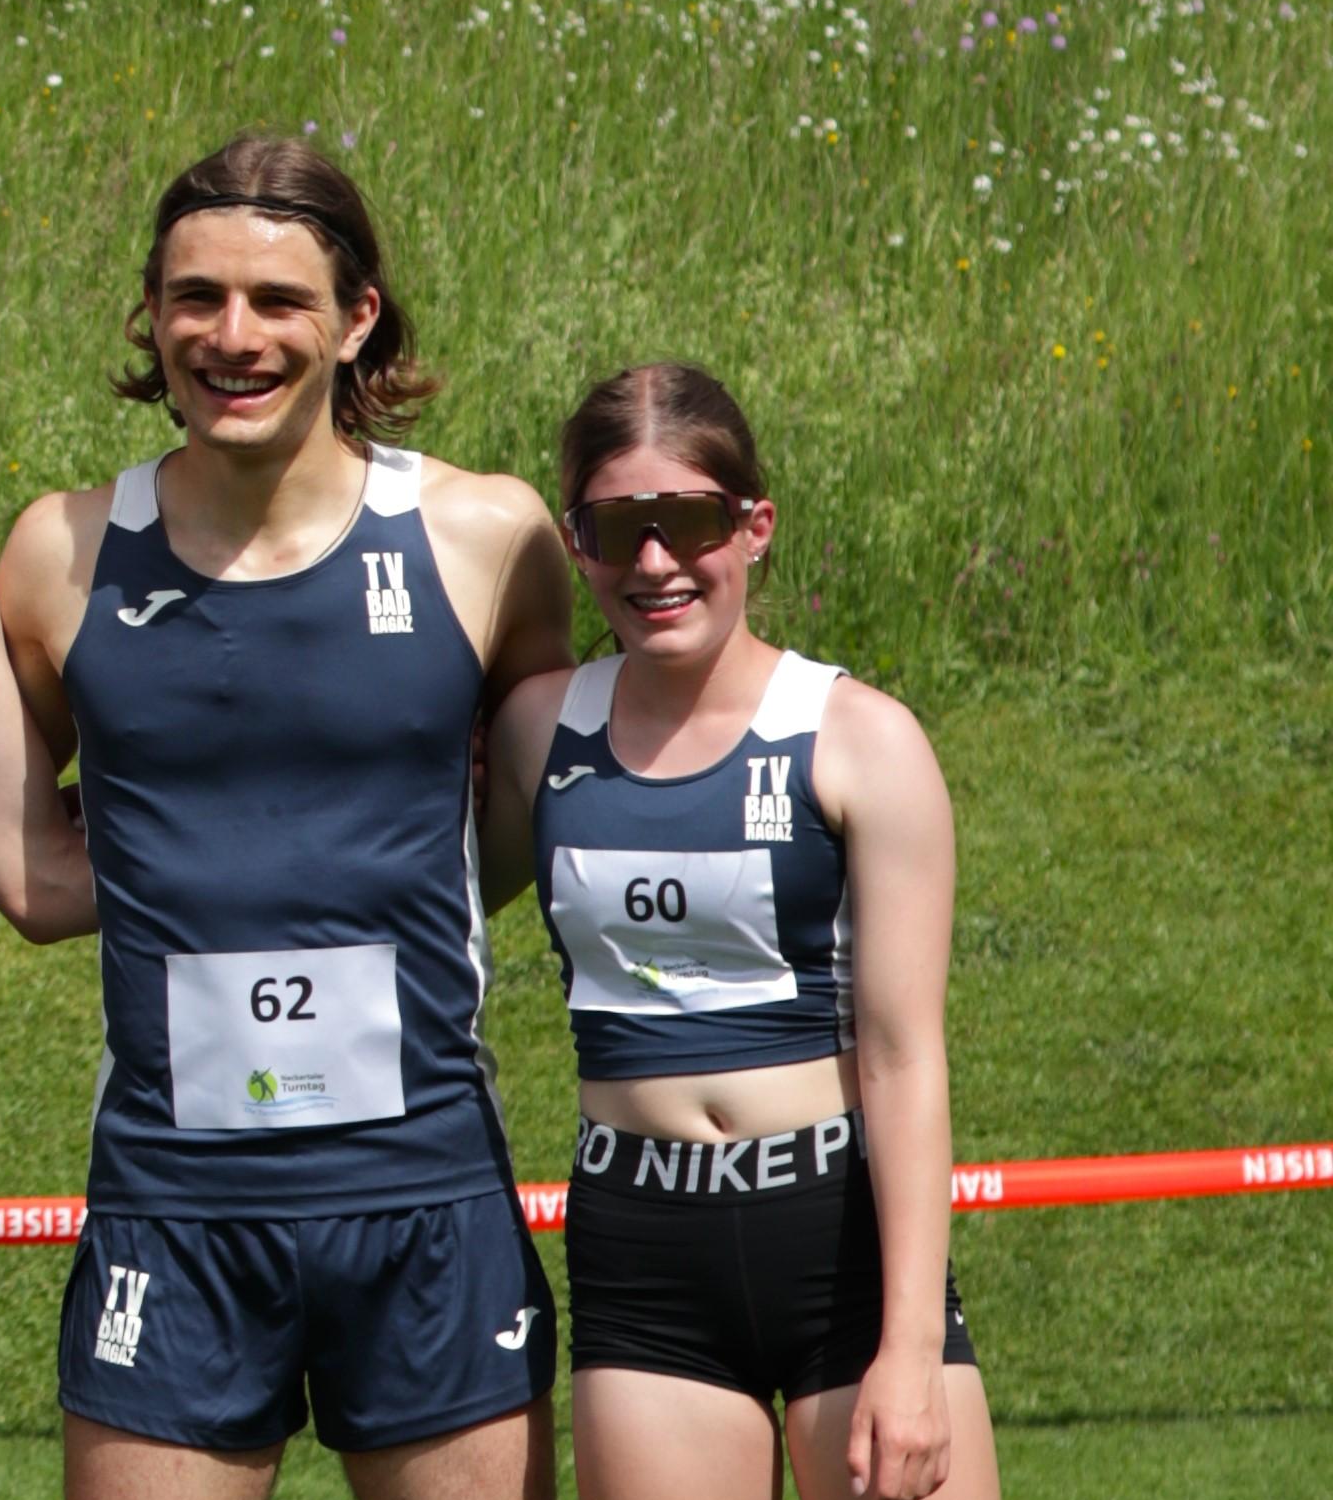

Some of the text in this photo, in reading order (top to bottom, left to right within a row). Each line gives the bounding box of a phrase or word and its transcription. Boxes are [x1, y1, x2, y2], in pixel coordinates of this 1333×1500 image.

[361, 552, 404, 590] TV
[365, 588, 412, 617] BAD
[369, 614, 414, 635] RAGAZ
[747, 755, 792, 795] TV
[744, 794, 792, 823] BAD
[744, 822, 794, 842] RAGAZ
[624, 876, 688, 924] 60
[250, 975, 317, 1024] 62
[281, 1081, 326, 1093] Turntag
[633, 1130, 798, 1195] NIKE
[105, 1264, 150, 1316] TV
[98, 1308, 143, 1347] BAD
[94, 1338, 138, 1368] RAGAZ
